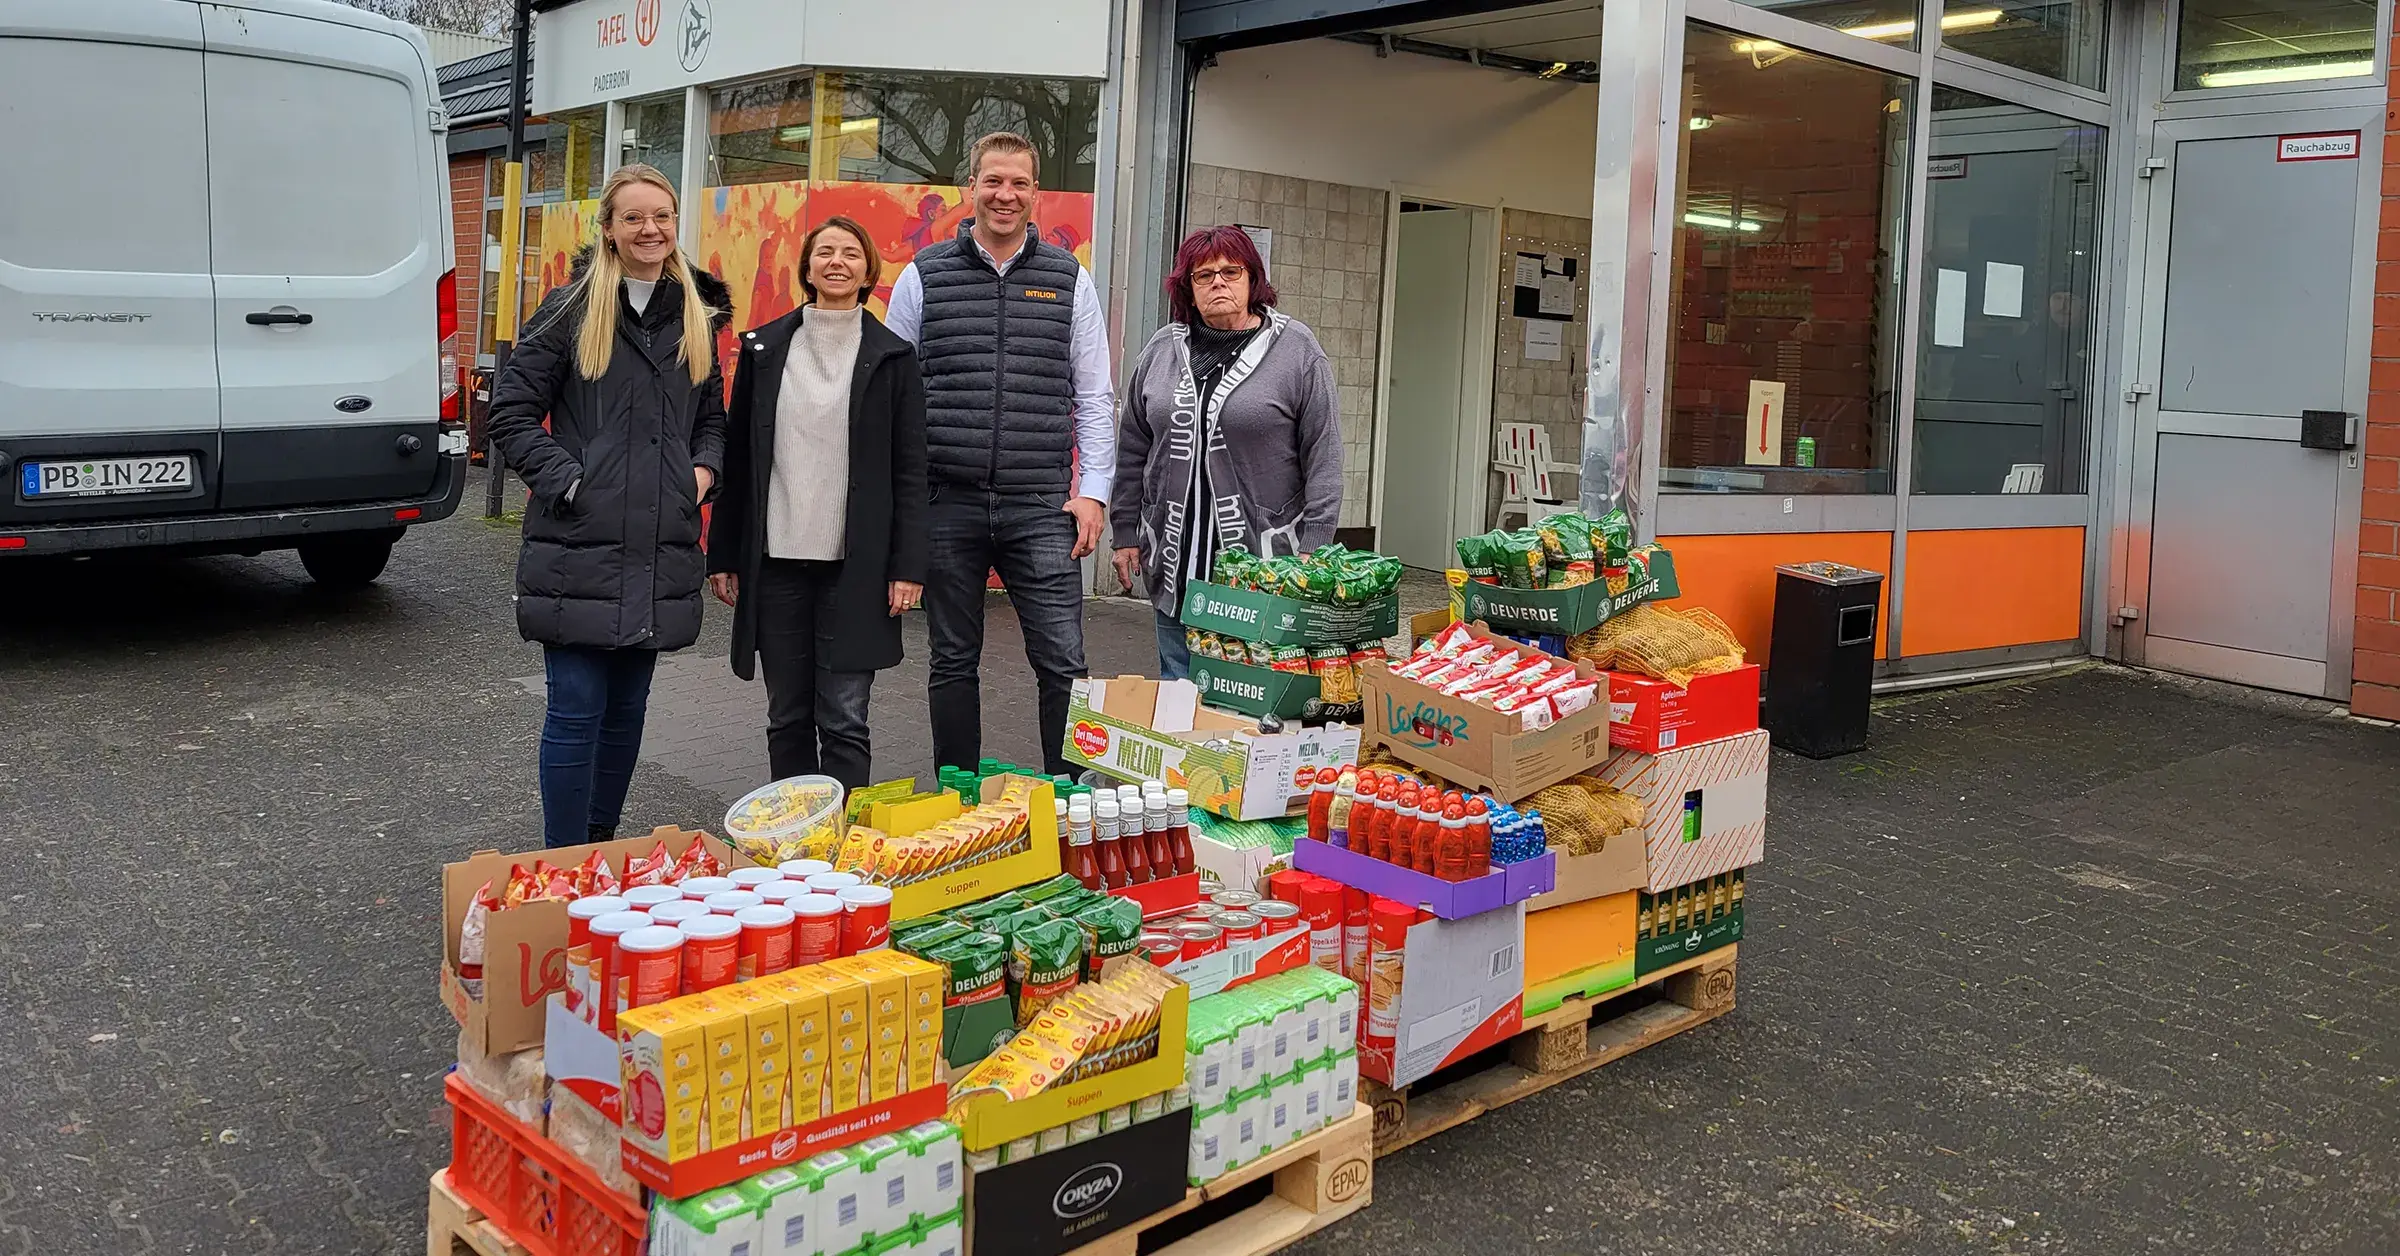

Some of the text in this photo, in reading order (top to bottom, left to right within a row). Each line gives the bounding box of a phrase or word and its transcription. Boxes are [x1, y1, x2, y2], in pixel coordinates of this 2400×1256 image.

[597, 13, 627, 48] TAFEL
[593, 69, 631, 93] PADERBORN
[2286, 142, 2351, 154] Rauchabzug
[1025, 290, 1057, 299] INTILION
[32, 312, 151, 323] TRANSIT
[344, 399, 367, 410] Ford
[43, 461, 186, 489] PB IN 222
[1207, 600, 1259, 625] DELVERDE
[1490, 602, 1559, 623] DELVERDE
[1213, 677, 1265, 702] DELVERDE
[1660, 689, 1688, 702] Apfelmus
[1075, 728, 1107, 748] Del Monte
[1117, 735, 1164, 780] MELON
[1298, 742, 1320, 758] MELON
[775, 811, 805, 828] HARIBO
[945, 878, 980, 895] Suppen
[1710, 975, 1731, 996] EPAL
[1066, 1089, 1103, 1108] Suppen
[807, 1123, 848, 1144] Qualität
[850, 1119, 867, 1131] seit
[1062, 1174, 1113, 1206] ORYZA
[1331, 1165, 1362, 1197] EPAL
